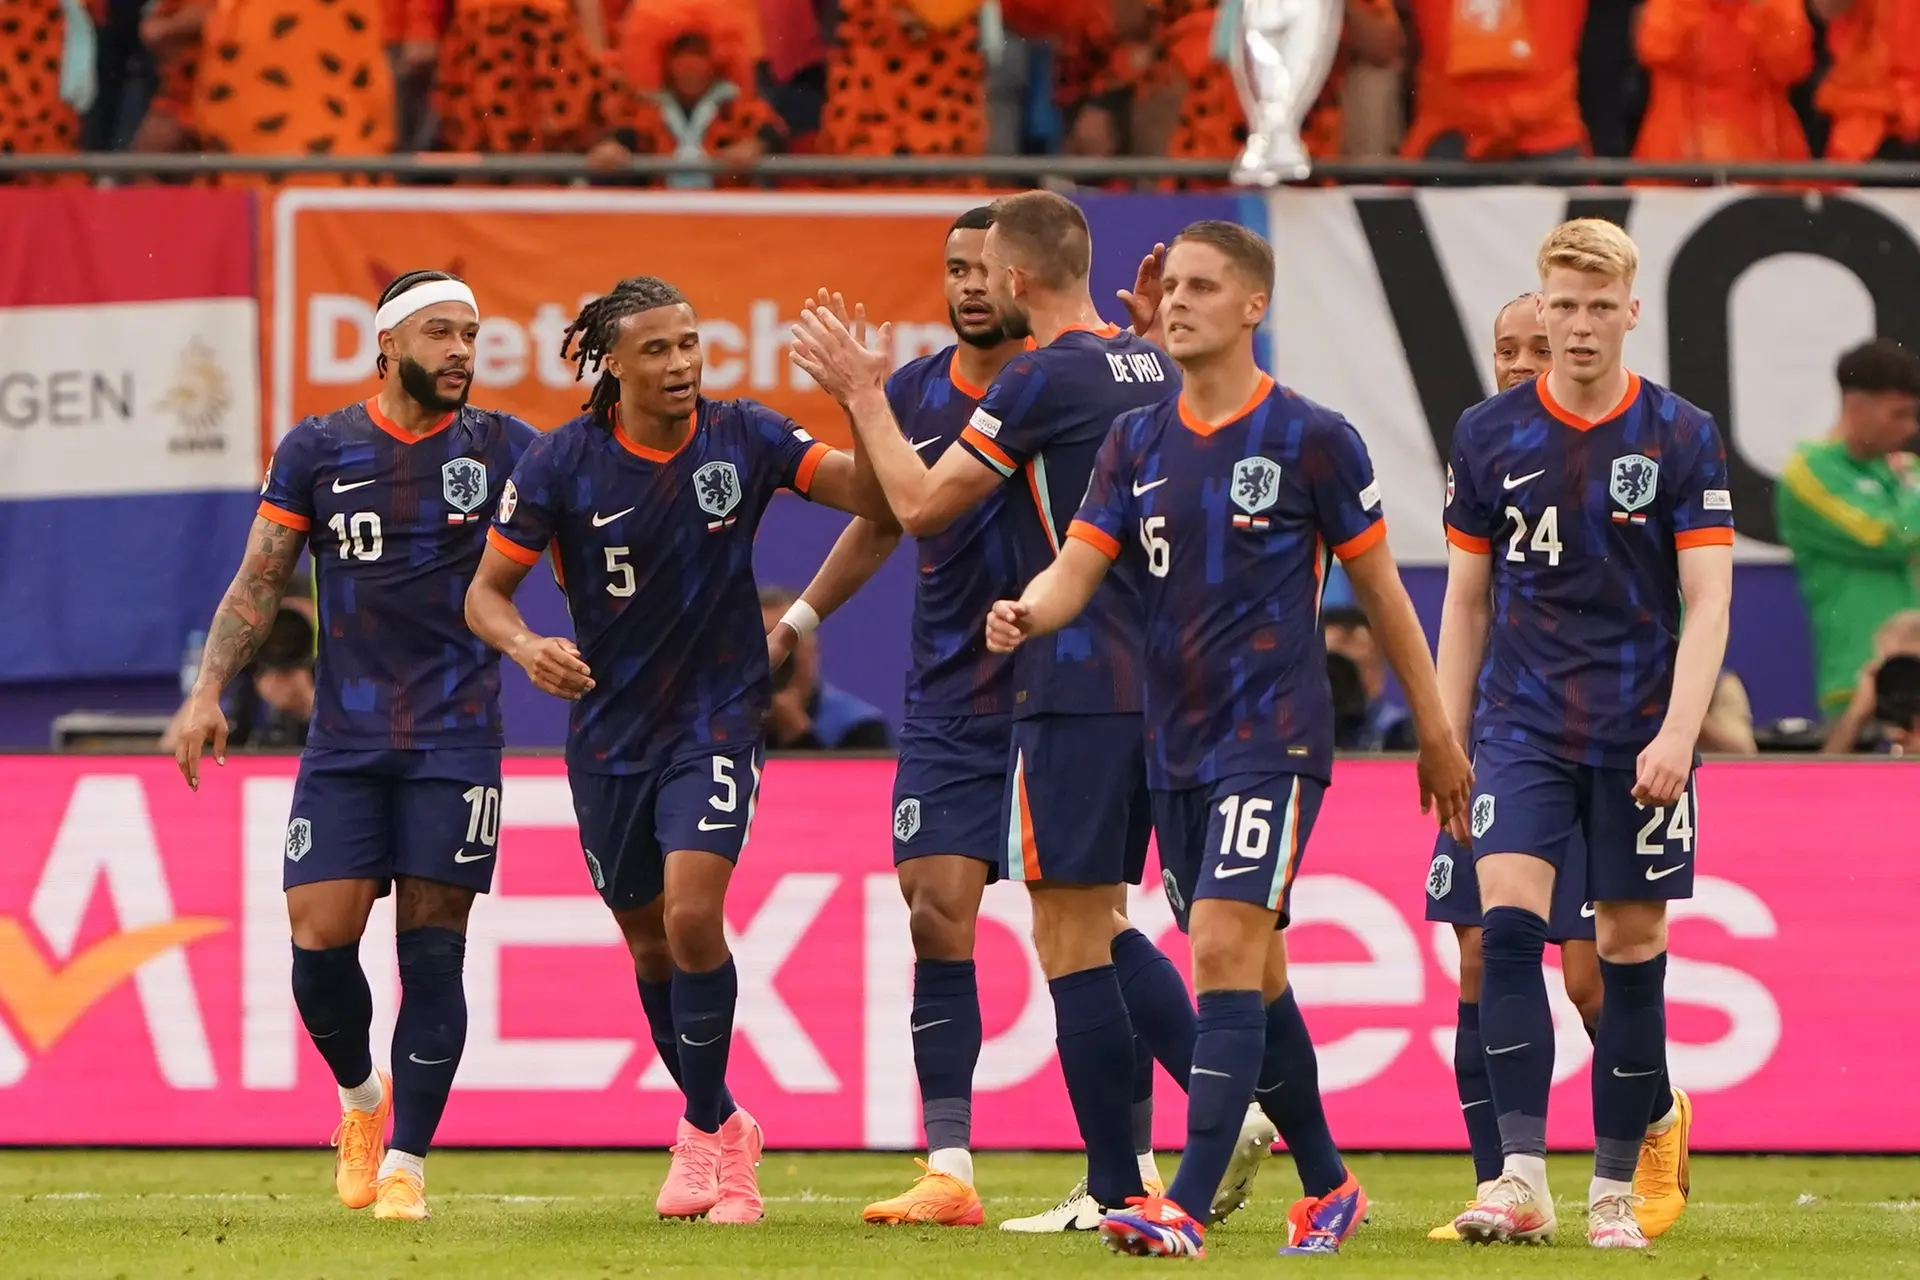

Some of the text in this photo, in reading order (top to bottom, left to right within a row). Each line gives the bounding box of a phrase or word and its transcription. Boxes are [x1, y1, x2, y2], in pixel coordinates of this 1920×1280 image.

[1105, 352, 1165, 382] DE VRIJ
[0, 370, 134, 430] GEN
[328, 511, 383, 561] 10
[1504, 505, 1563, 566] 24
[604, 546, 636, 597] 5
[708, 755, 737, 813] 5
[462, 785, 500, 847] 10
[1218, 794, 1273, 860] 16
[1636, 791, 1693, 855] 24
[0, 774, 1782, 1148] AlExpes
